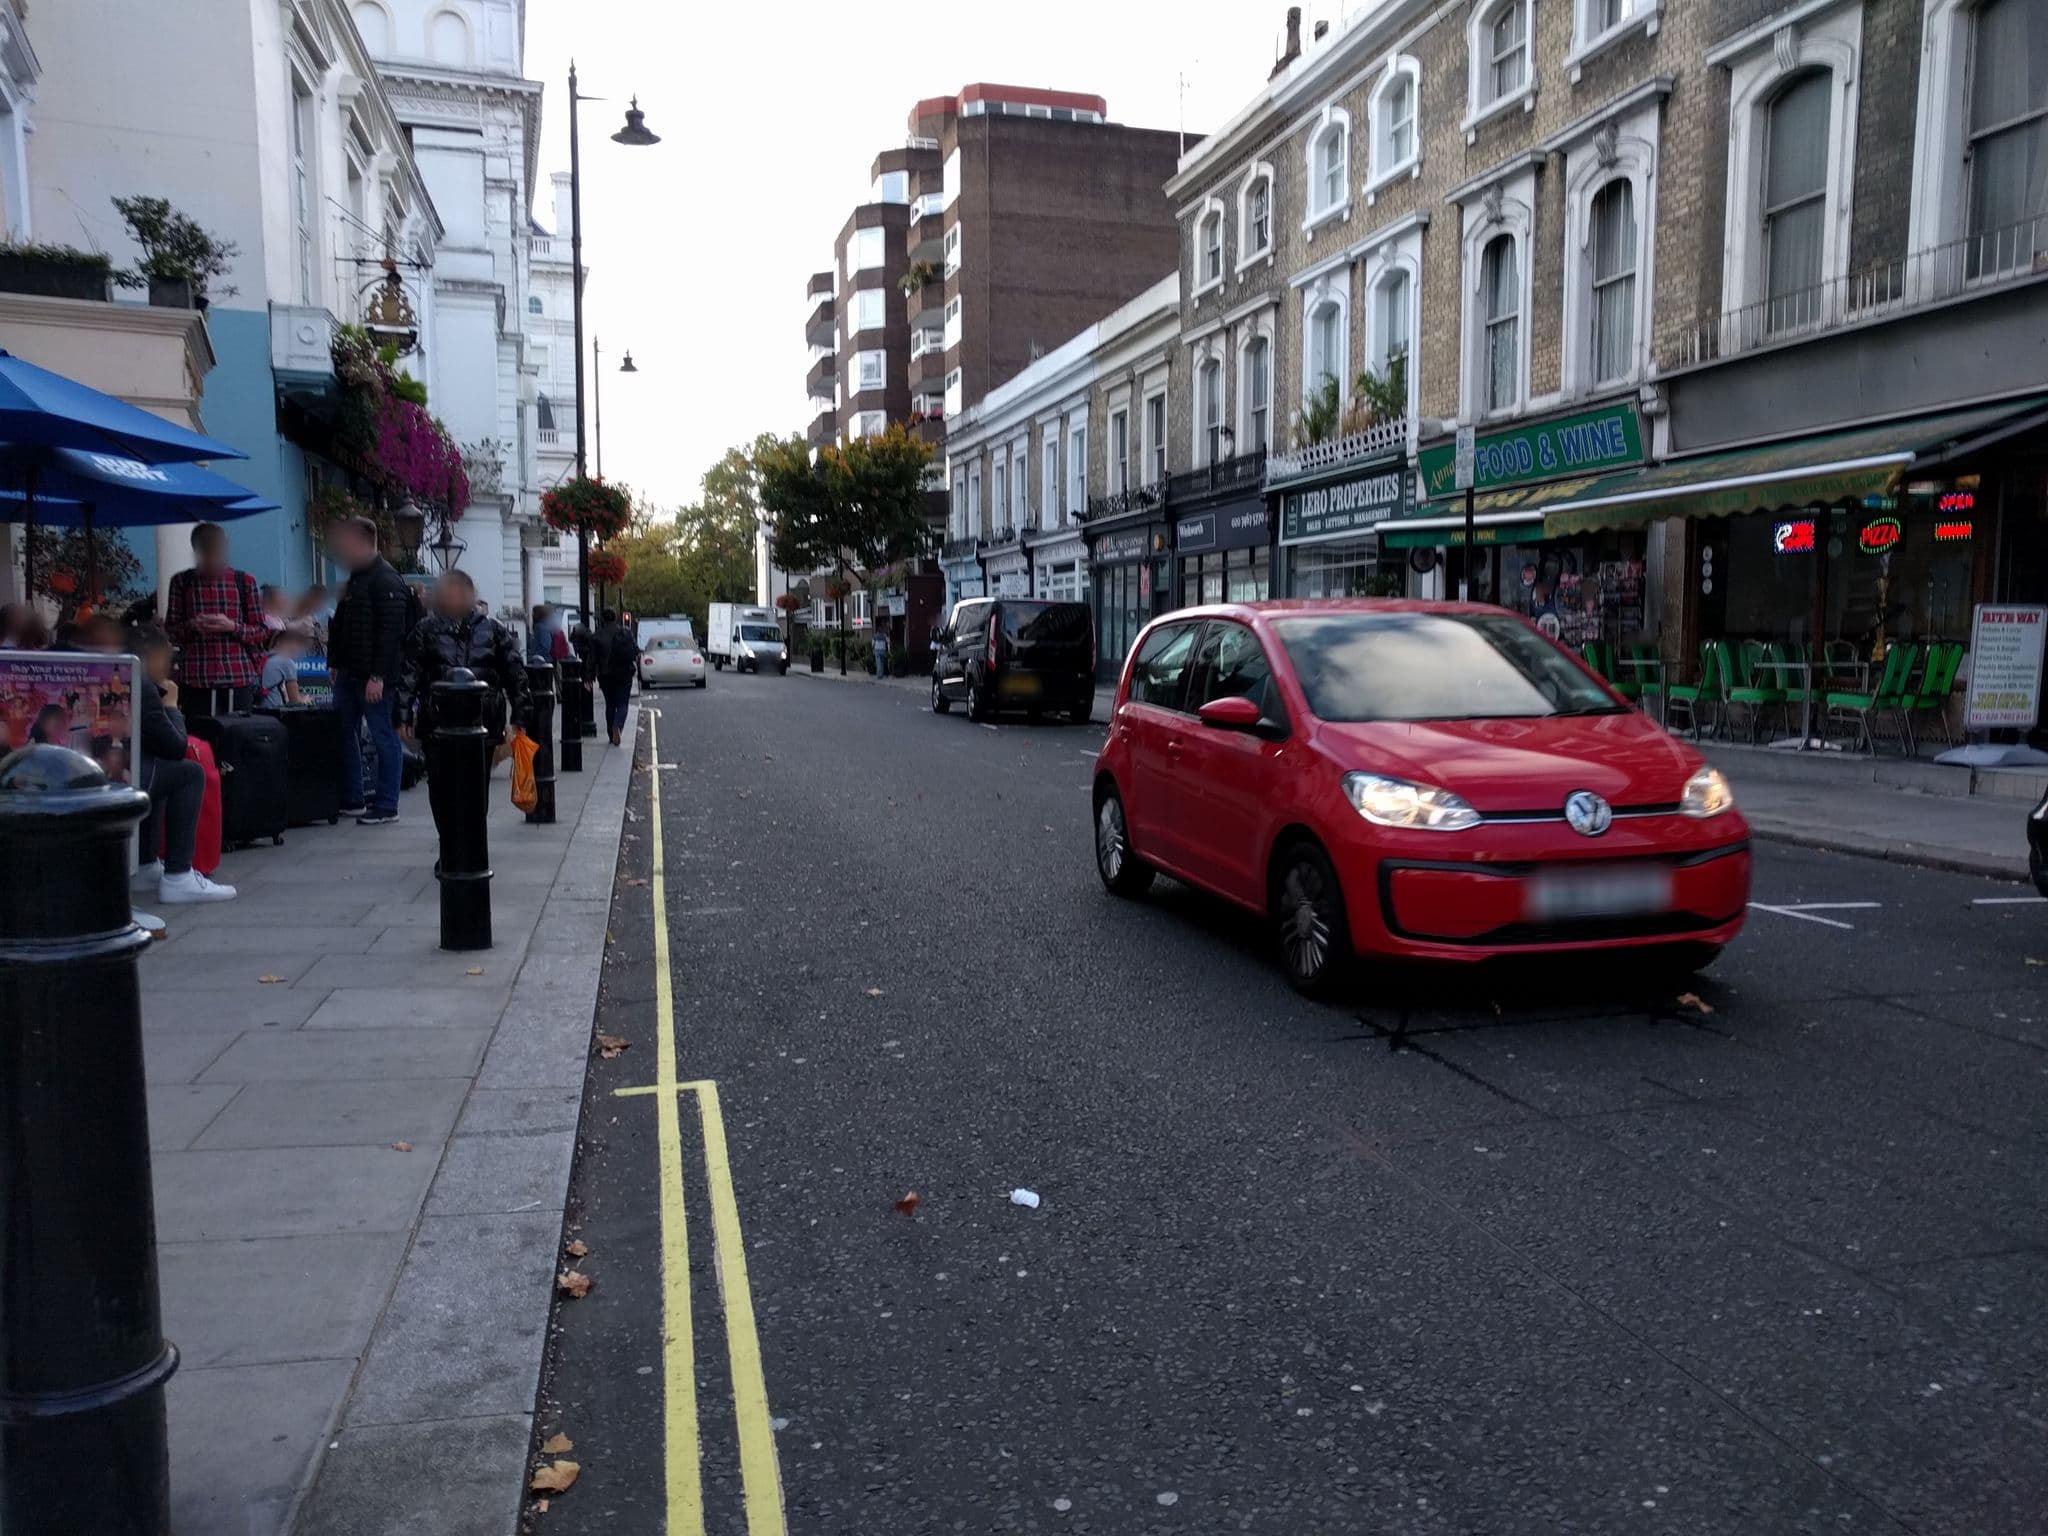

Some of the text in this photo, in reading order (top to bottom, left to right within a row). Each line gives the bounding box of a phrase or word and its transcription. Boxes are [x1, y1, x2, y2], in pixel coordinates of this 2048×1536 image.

[1475, 437, 1533, 481] FOOD
[1538, 432, 1557, 469] &
[1557, 416, 1628, 466] WINE
[1300, 488, 1328, 518] LERO
[1329, 472, 1399, 513] PROPERTIES
[1939, 494, 1974, 509] OPEN
[1306, 506, 1391, 533] SALES LETTINGS MANAGEMENT
[1862, 524, 1899, 546] PIZZA
[1982, 611, 2040, 624] BITE WAY
